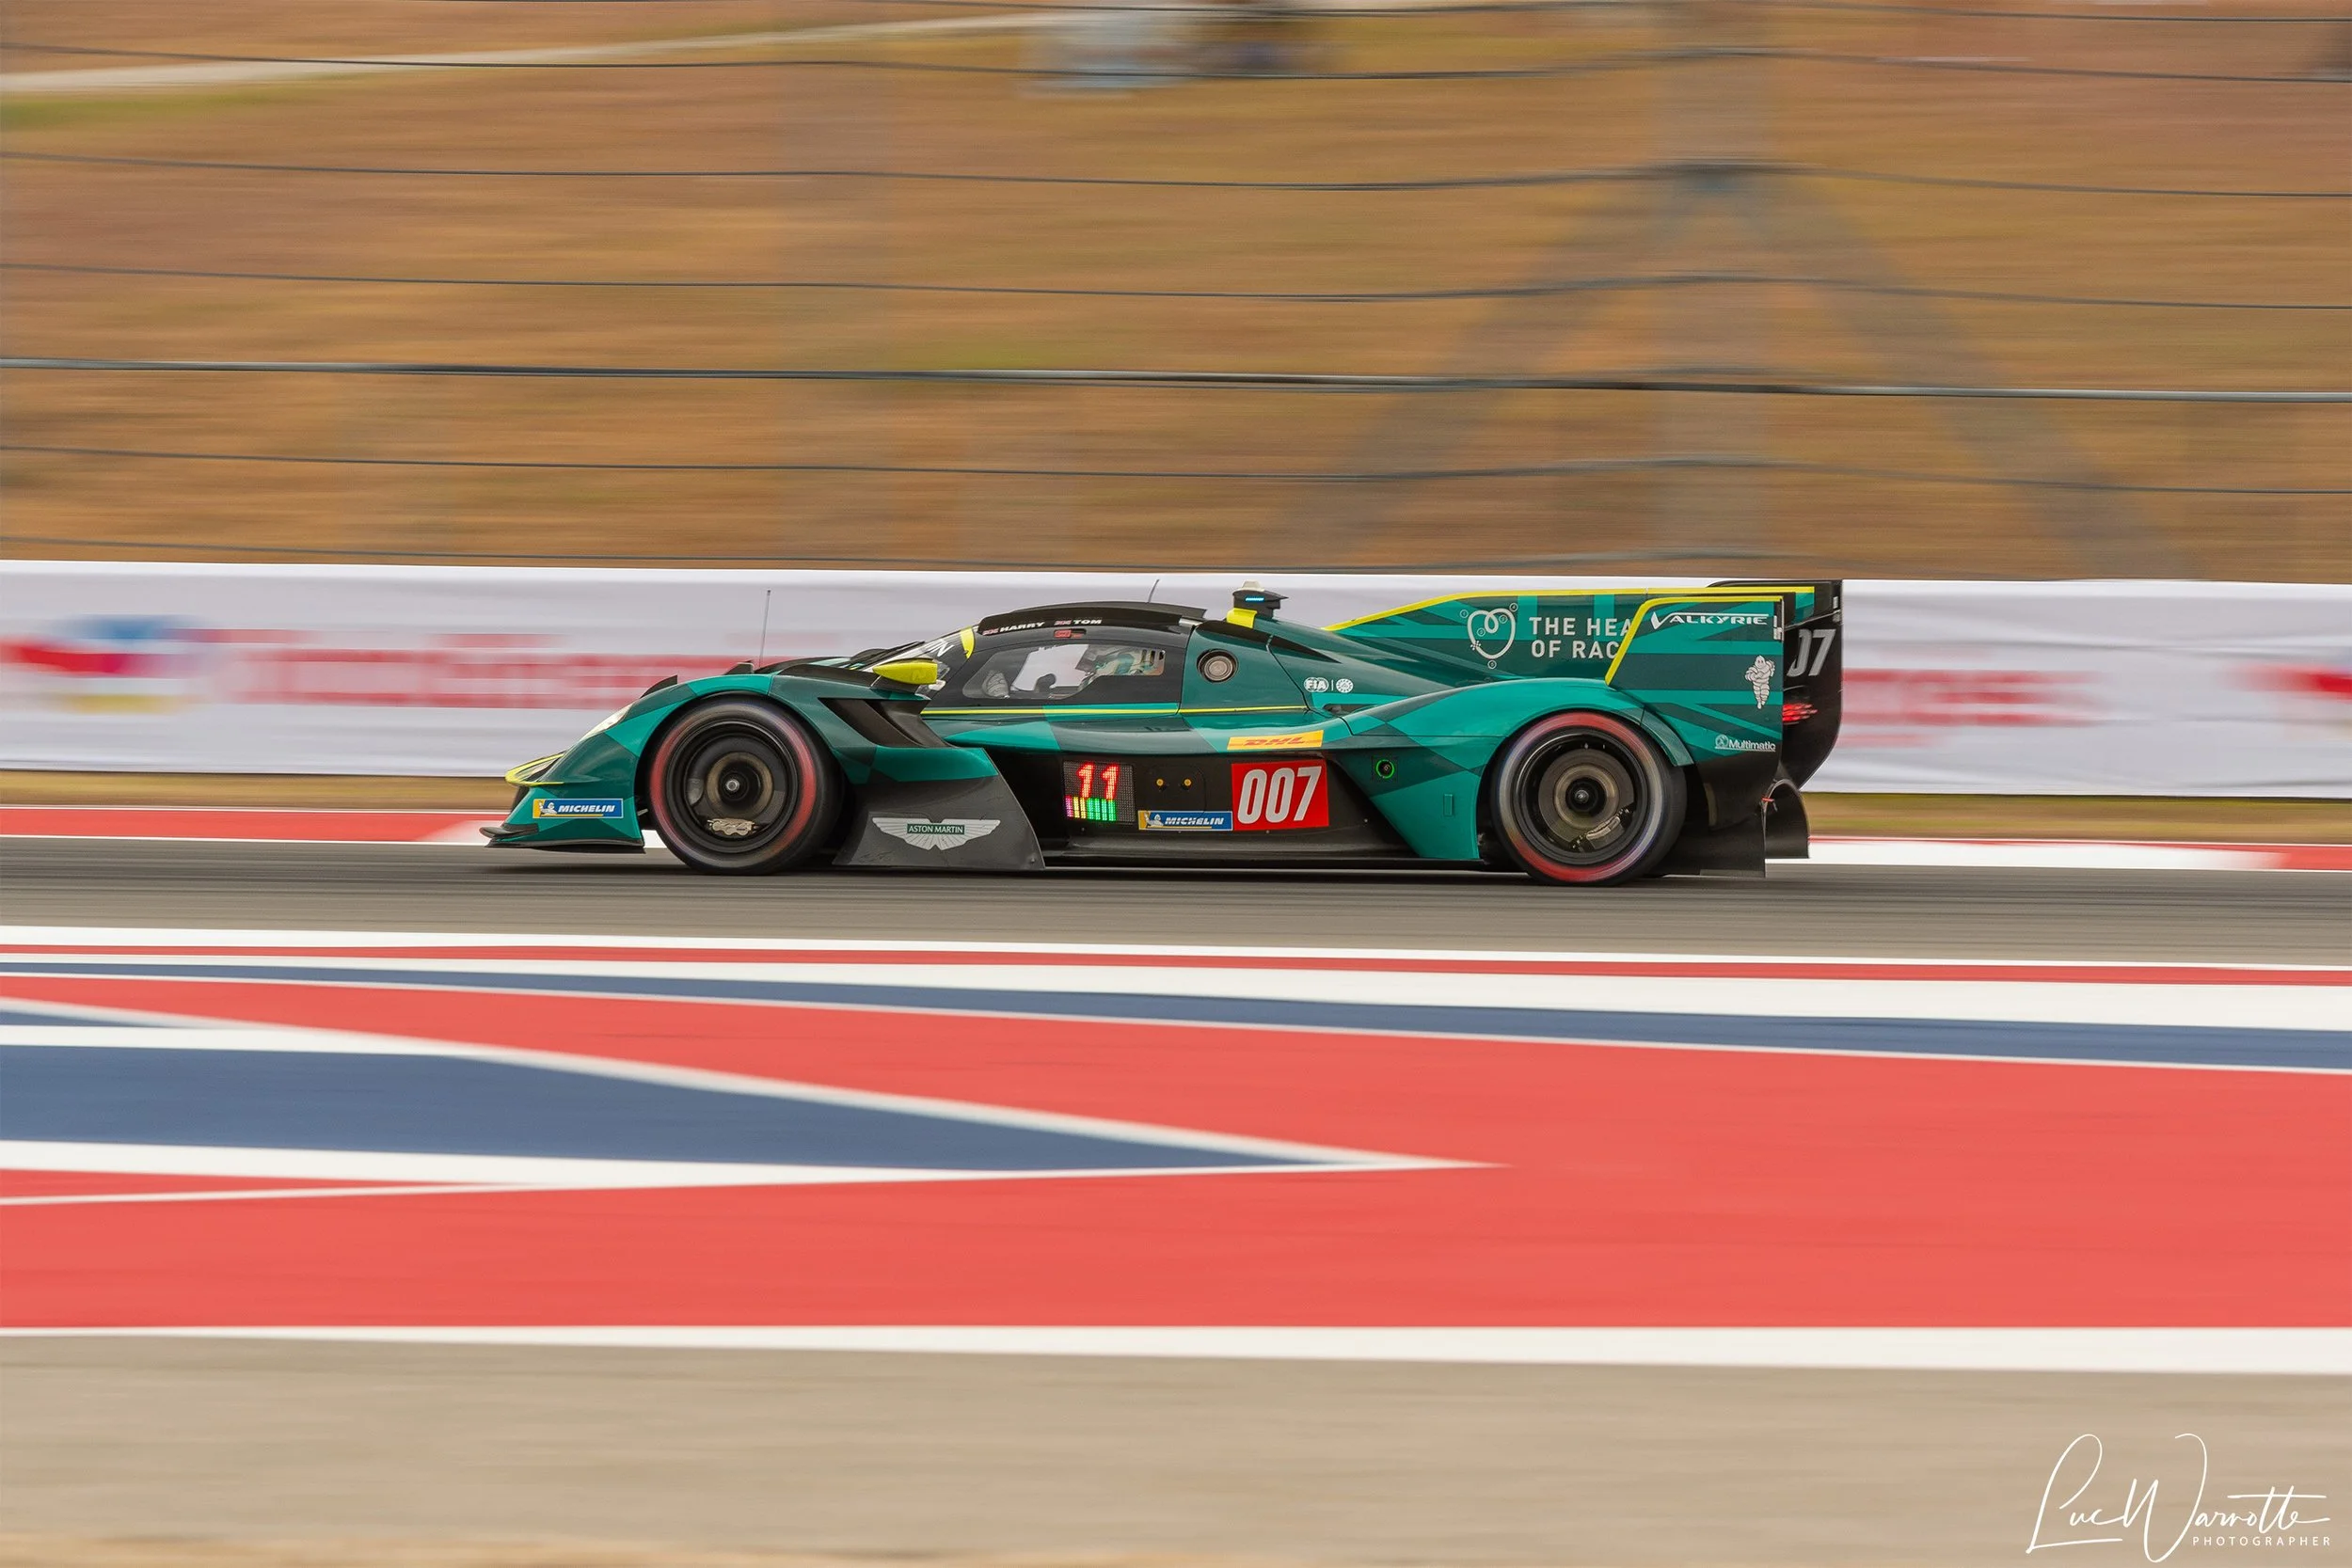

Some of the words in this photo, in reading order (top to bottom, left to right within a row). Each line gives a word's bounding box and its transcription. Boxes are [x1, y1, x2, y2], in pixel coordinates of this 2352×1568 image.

[999, 621, 1045, 633] HARRY
[1529, 617, 1576, 636] THE
[1650, 612, 1770, 630] VALKYRIE
[1532, 640, 1562, 658] OF
[1305, 679, 1327, 691] FIA
[1244, 736, 1305, 746] DHL
[1728, 739, 1776, 751] Multimatic
[1078, 763, 1119, 800] 11
[1237, 766, 1322, 825] 007
[908, 825, 933, 833] ASTON
